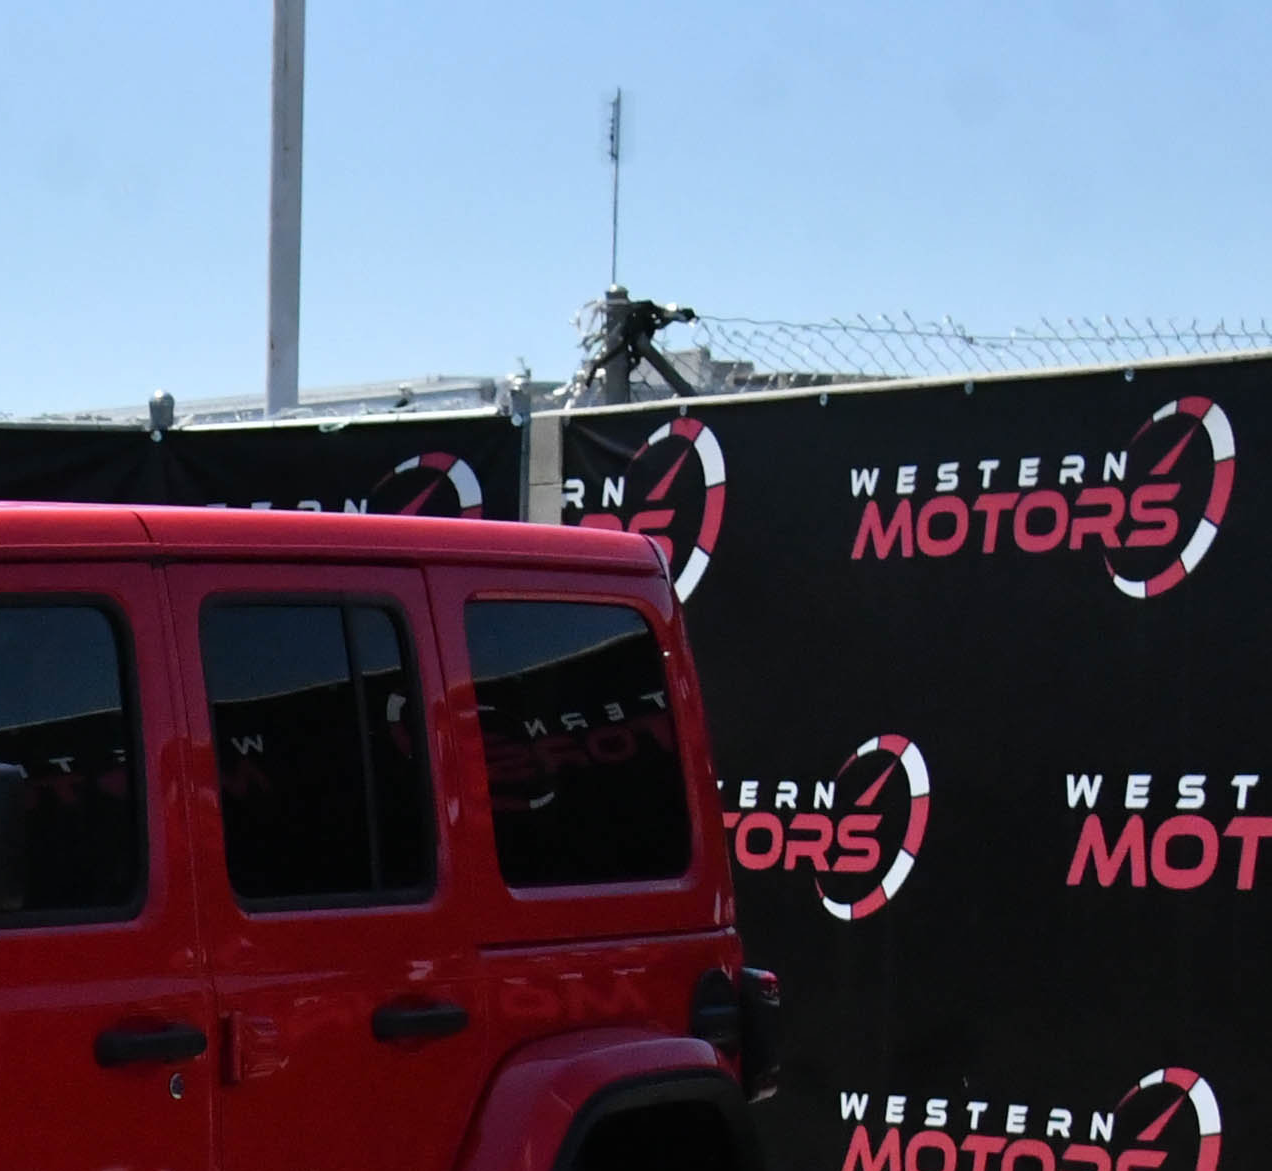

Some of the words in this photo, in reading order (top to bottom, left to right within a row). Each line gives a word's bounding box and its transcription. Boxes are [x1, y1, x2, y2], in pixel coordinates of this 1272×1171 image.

[850, 450, 1128, 498] WESTERN
[852, 484, 1180, 559] MOTORS
[1066, 773, 1260, 810] WEST
[1066, 814, 1272, 890] MOT
[840, 1091, 1115, 1143] WESTERN
